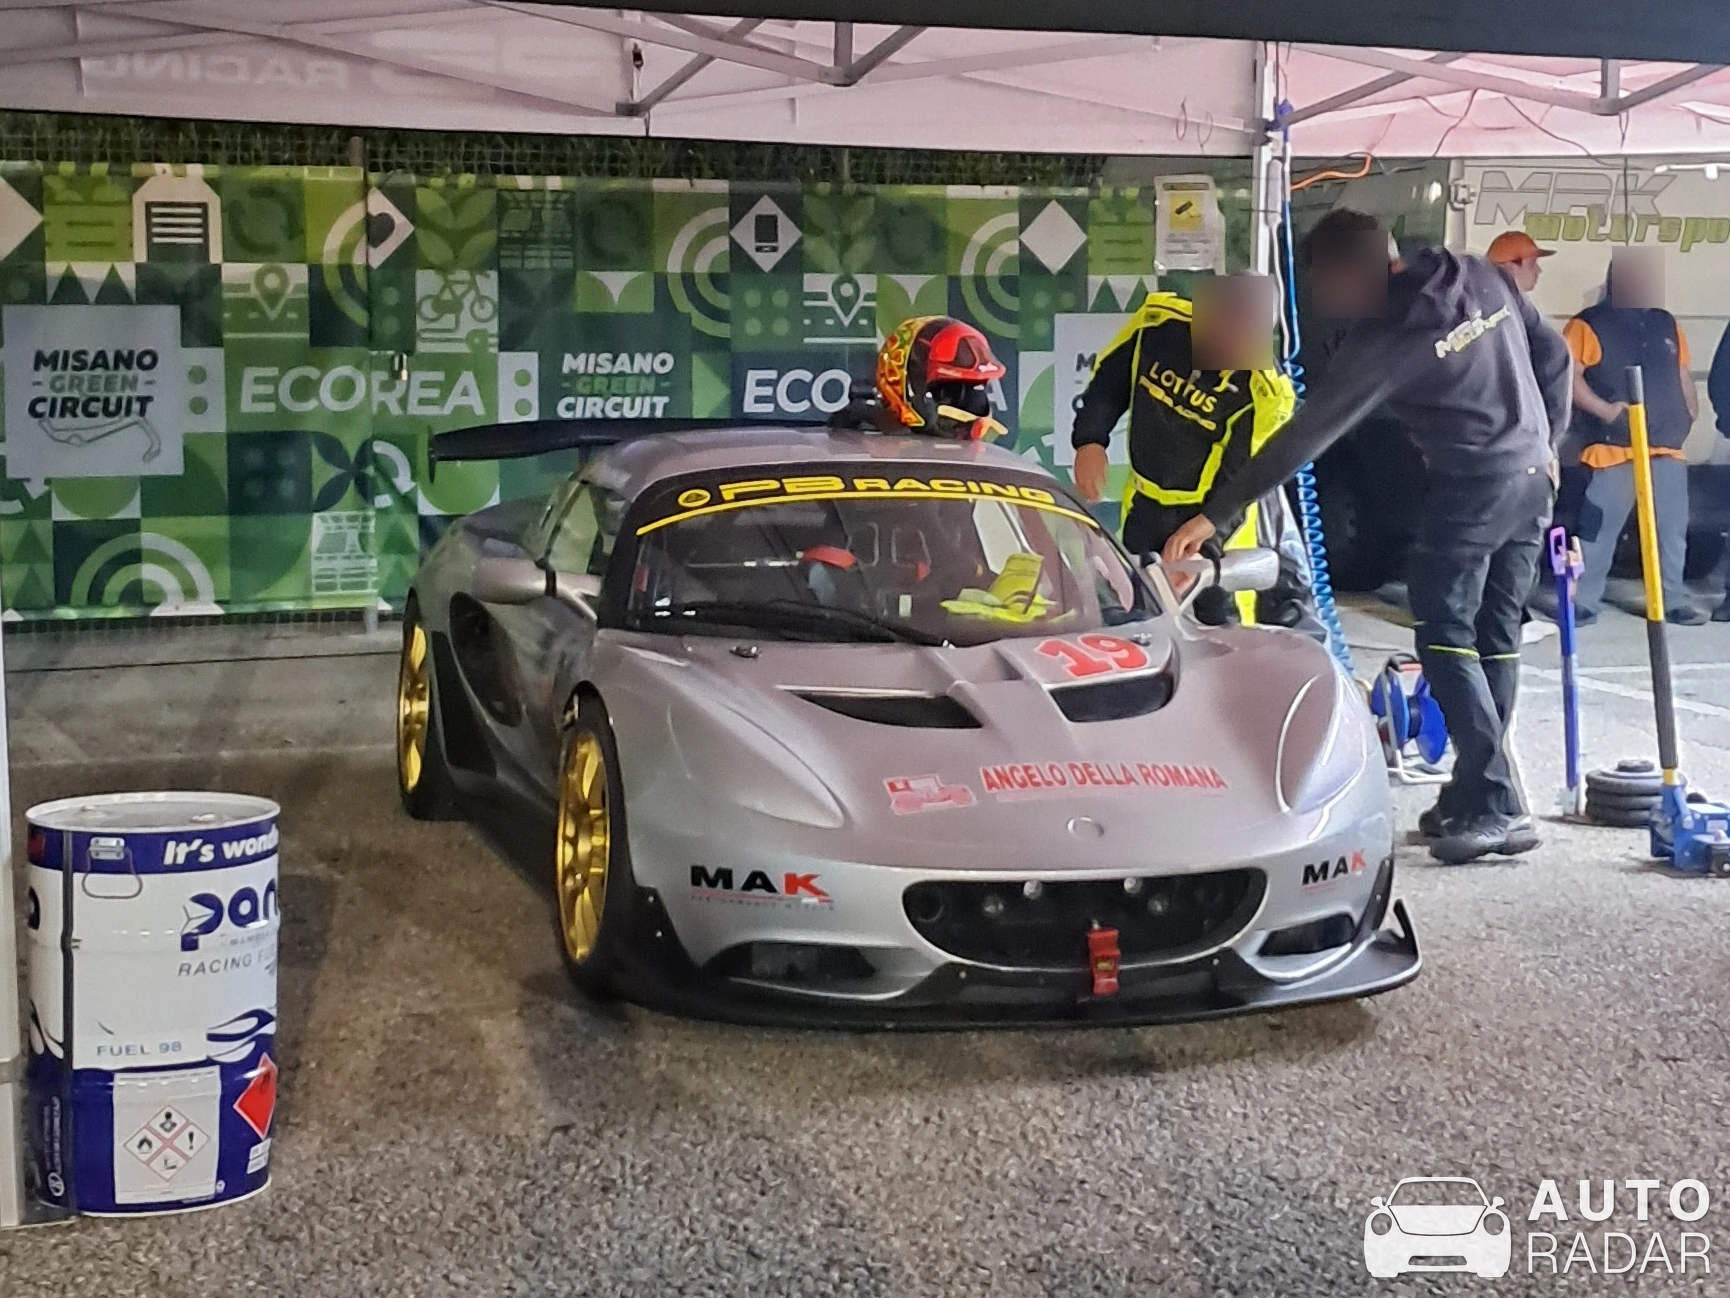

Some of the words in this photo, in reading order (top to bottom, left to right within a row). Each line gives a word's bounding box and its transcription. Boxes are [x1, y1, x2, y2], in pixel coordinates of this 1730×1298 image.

[33, 349, 159, 372] MISANO
[562, 352, 675, 374] MISANO
[50, 374, 139, 394] GREEN
[240, 365, 486, 416] ECOREA
[575, 376, 656, 395] GREEN
[27, 396, 154, 419] CIRCUIT
[556, 396, 670, 419] CIRCUIT
[718, 476, 846, 501] PB
[854, 478, 1055, 504] RACING
[1033, 632, 1150, 678] 19
[980, 762, 1068, 791] ANGELO
[1067, 761, 1139, 787] DELLA
[1136, 762, 1229, 789] ROMANA
[163, 839, 214, 865] It's
[1302, 848, 1367, 886] MAK
[690, 865, 830, 897] MAK
[177, 954, 253, 977] RACING
[97, 1044, 151, 1057] FUEL
[159, 1040, 182, 1054] 98
